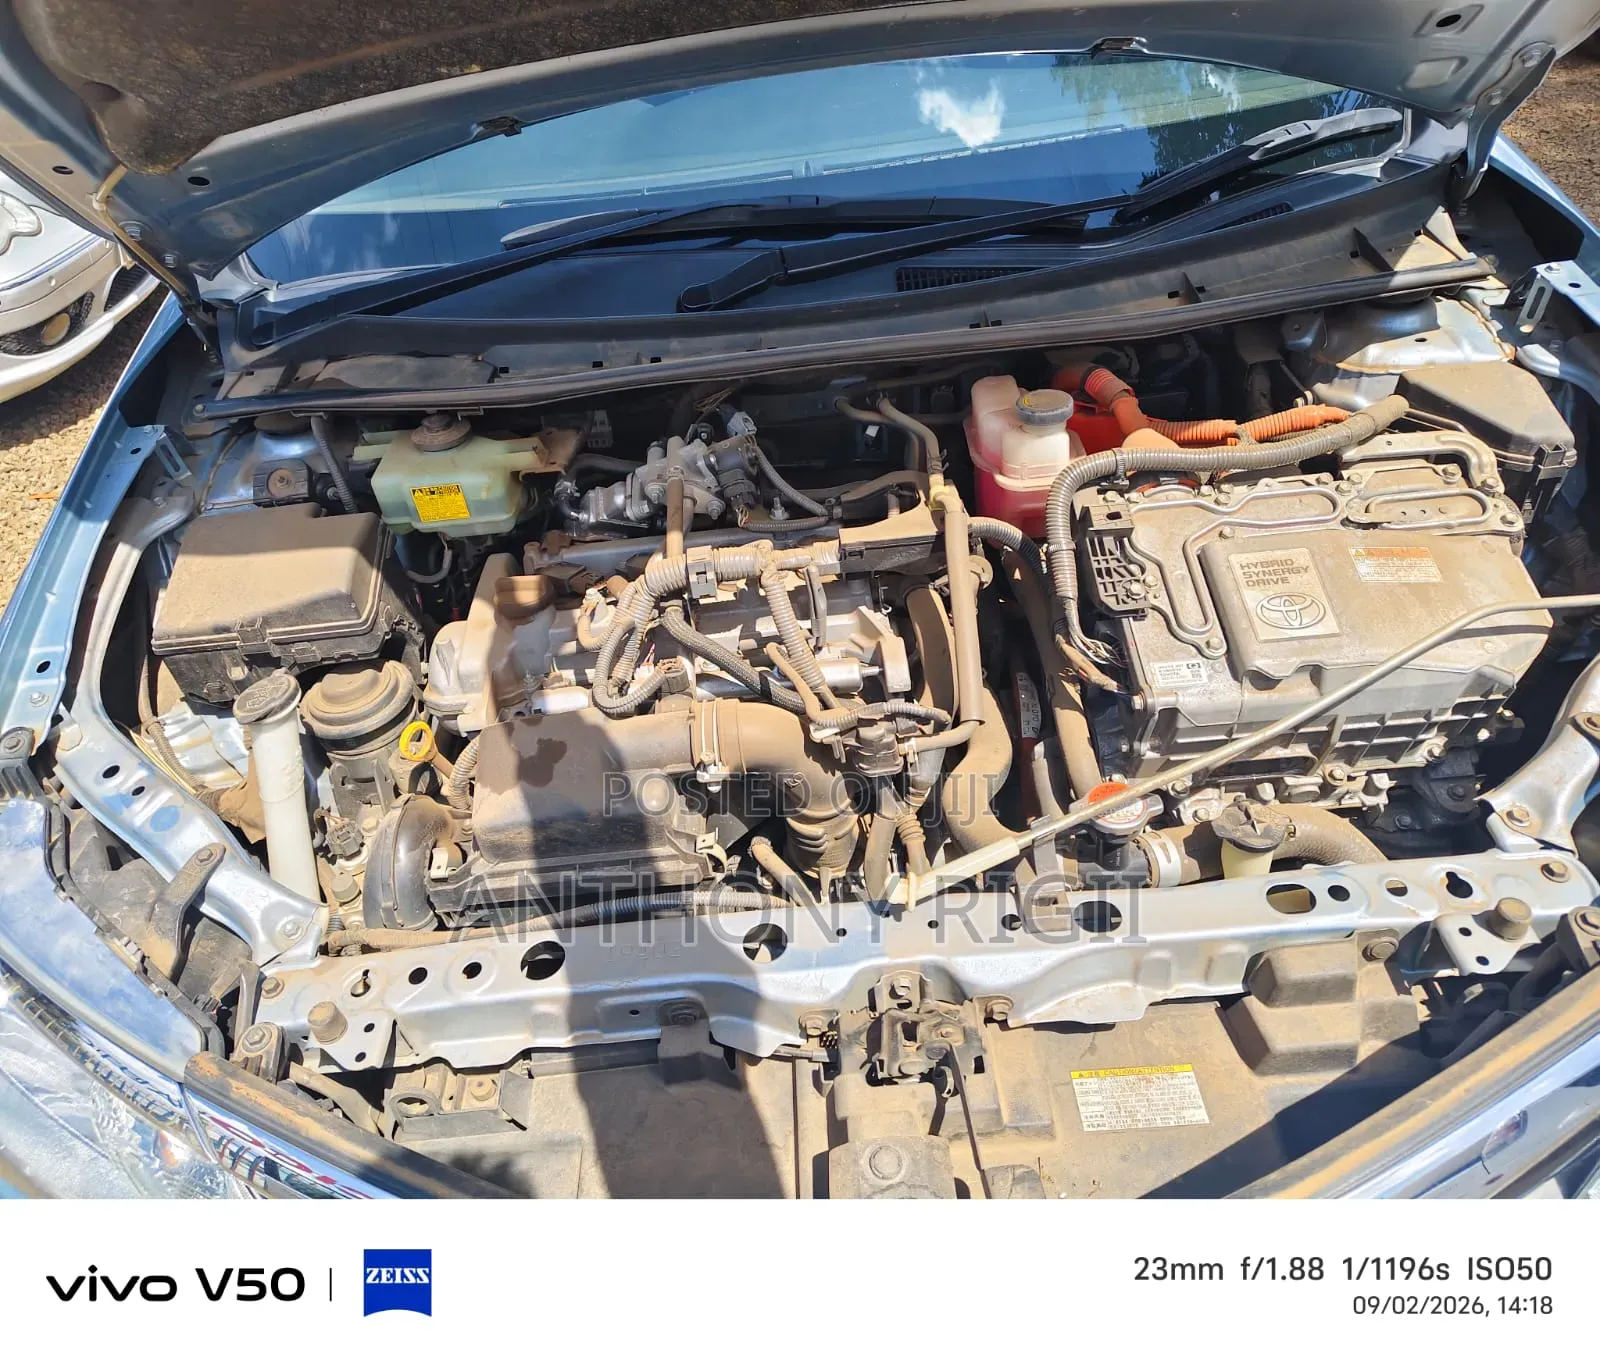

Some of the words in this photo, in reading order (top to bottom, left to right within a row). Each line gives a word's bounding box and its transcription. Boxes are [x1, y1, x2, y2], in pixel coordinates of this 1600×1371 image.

[1239, 558, 1294, 571] HYBRID
[1243, 566, 1309, 579] SYNERGY
[1246, 576, 1290, 588] DRIVE
